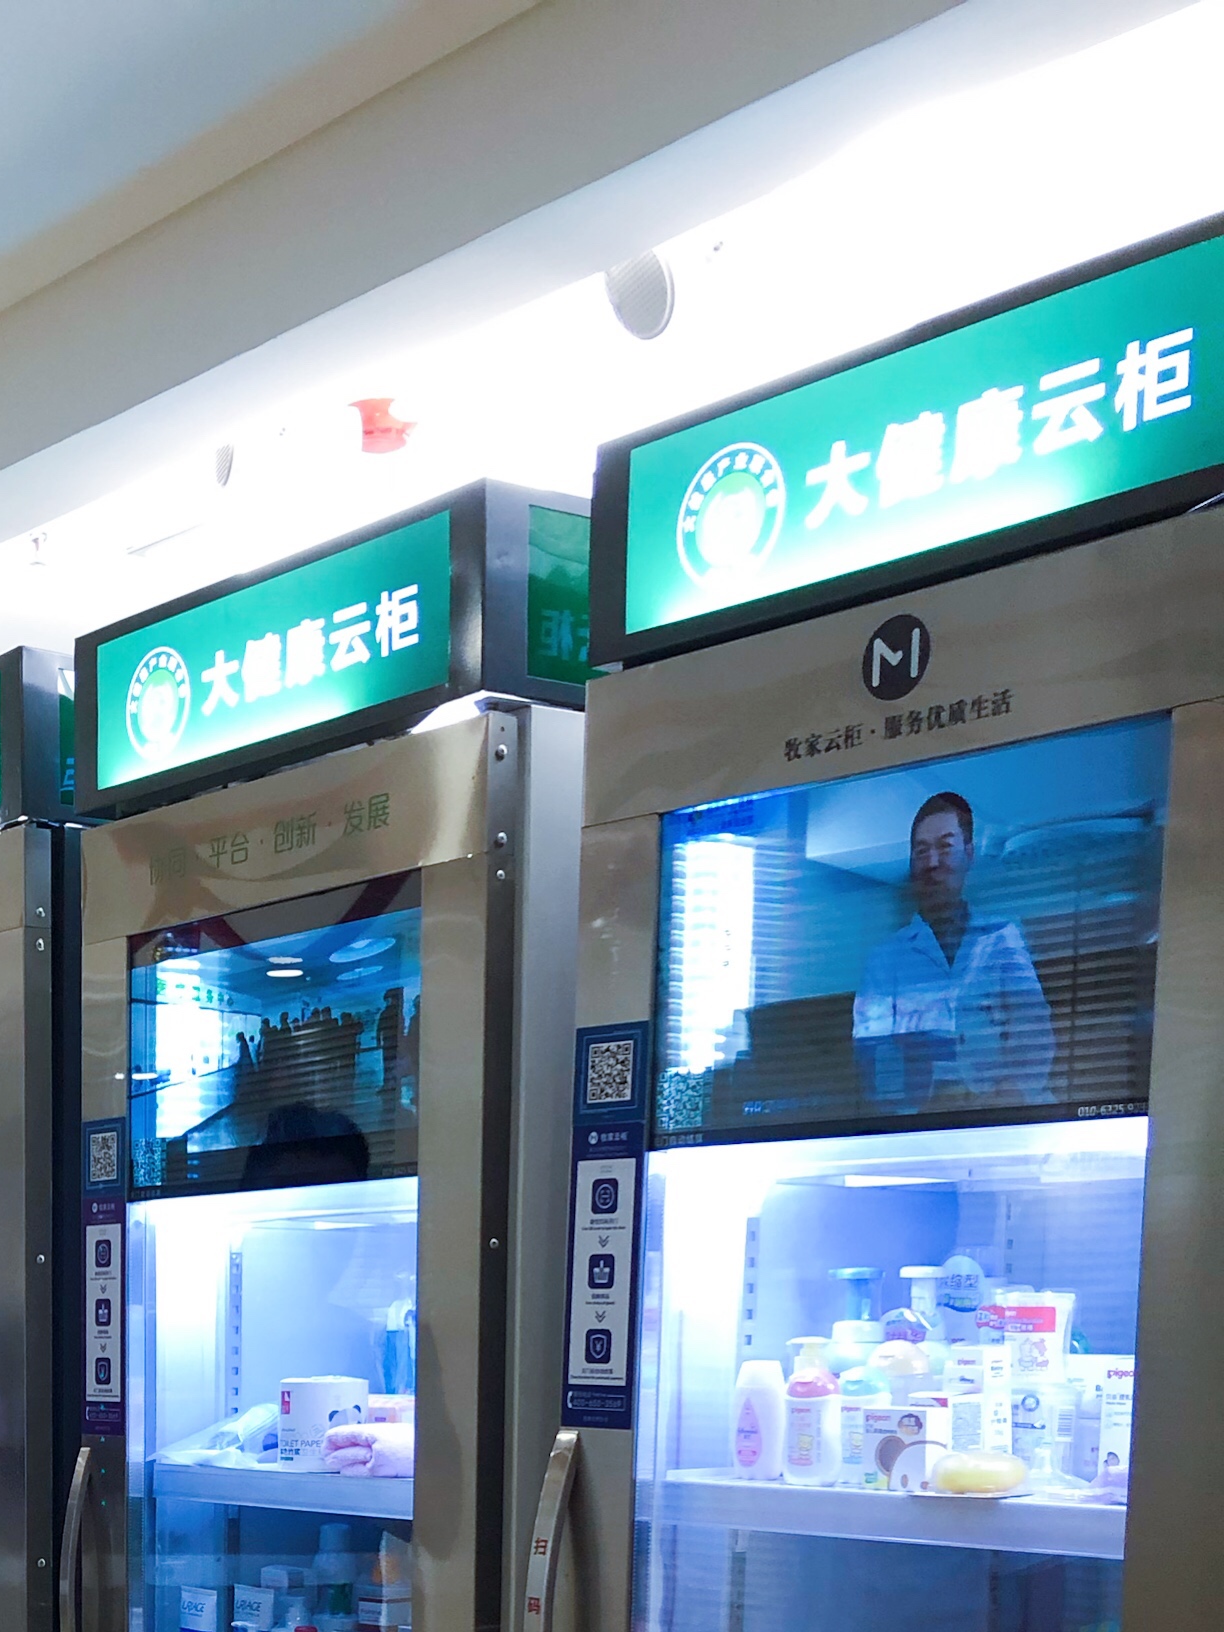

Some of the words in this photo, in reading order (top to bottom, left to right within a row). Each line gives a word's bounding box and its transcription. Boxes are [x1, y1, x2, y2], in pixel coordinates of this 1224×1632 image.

[804, 327, 1194, 531] 大健康云柜
[200, 583, 420, 714] 大健康云柜
[1106, 1368, 1135, 1379] pigeo
